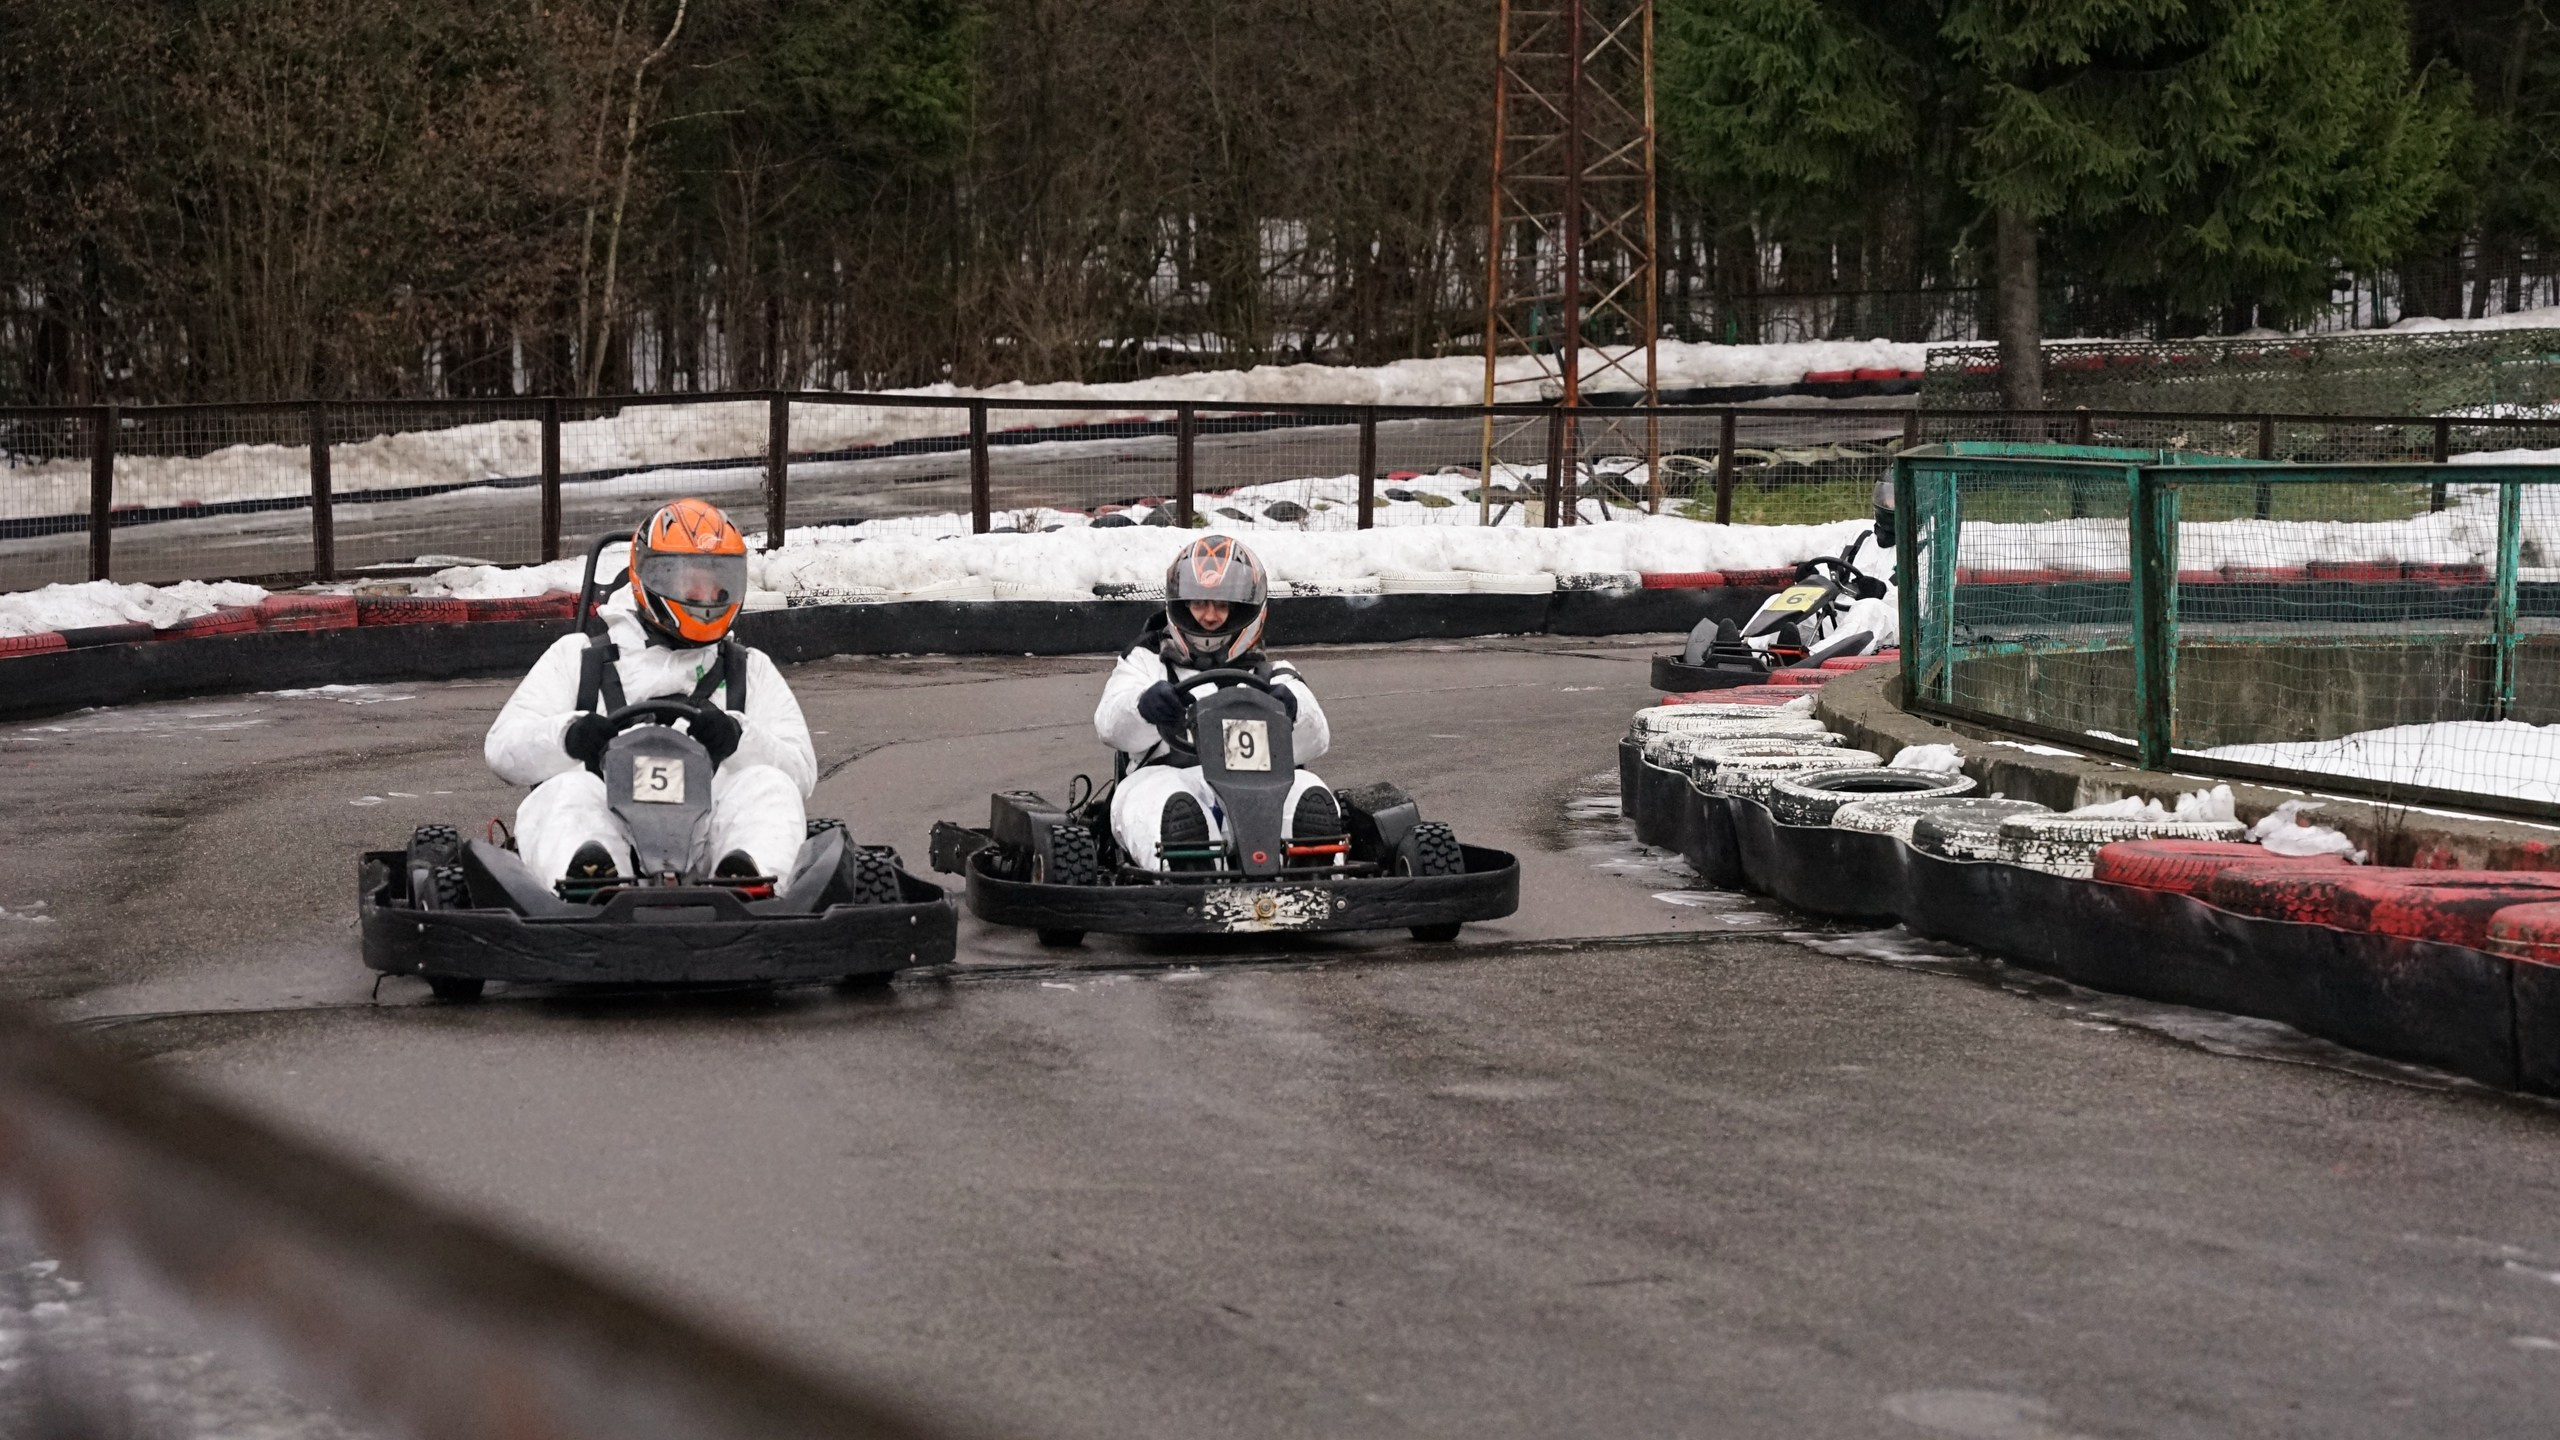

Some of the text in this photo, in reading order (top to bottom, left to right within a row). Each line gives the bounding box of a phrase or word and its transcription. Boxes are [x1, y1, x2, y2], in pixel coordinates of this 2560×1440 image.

[1786, 593, 1806, 605] 6
[1238, 731, 1255, 759] 9
[651, 766, 668, 791] 5
